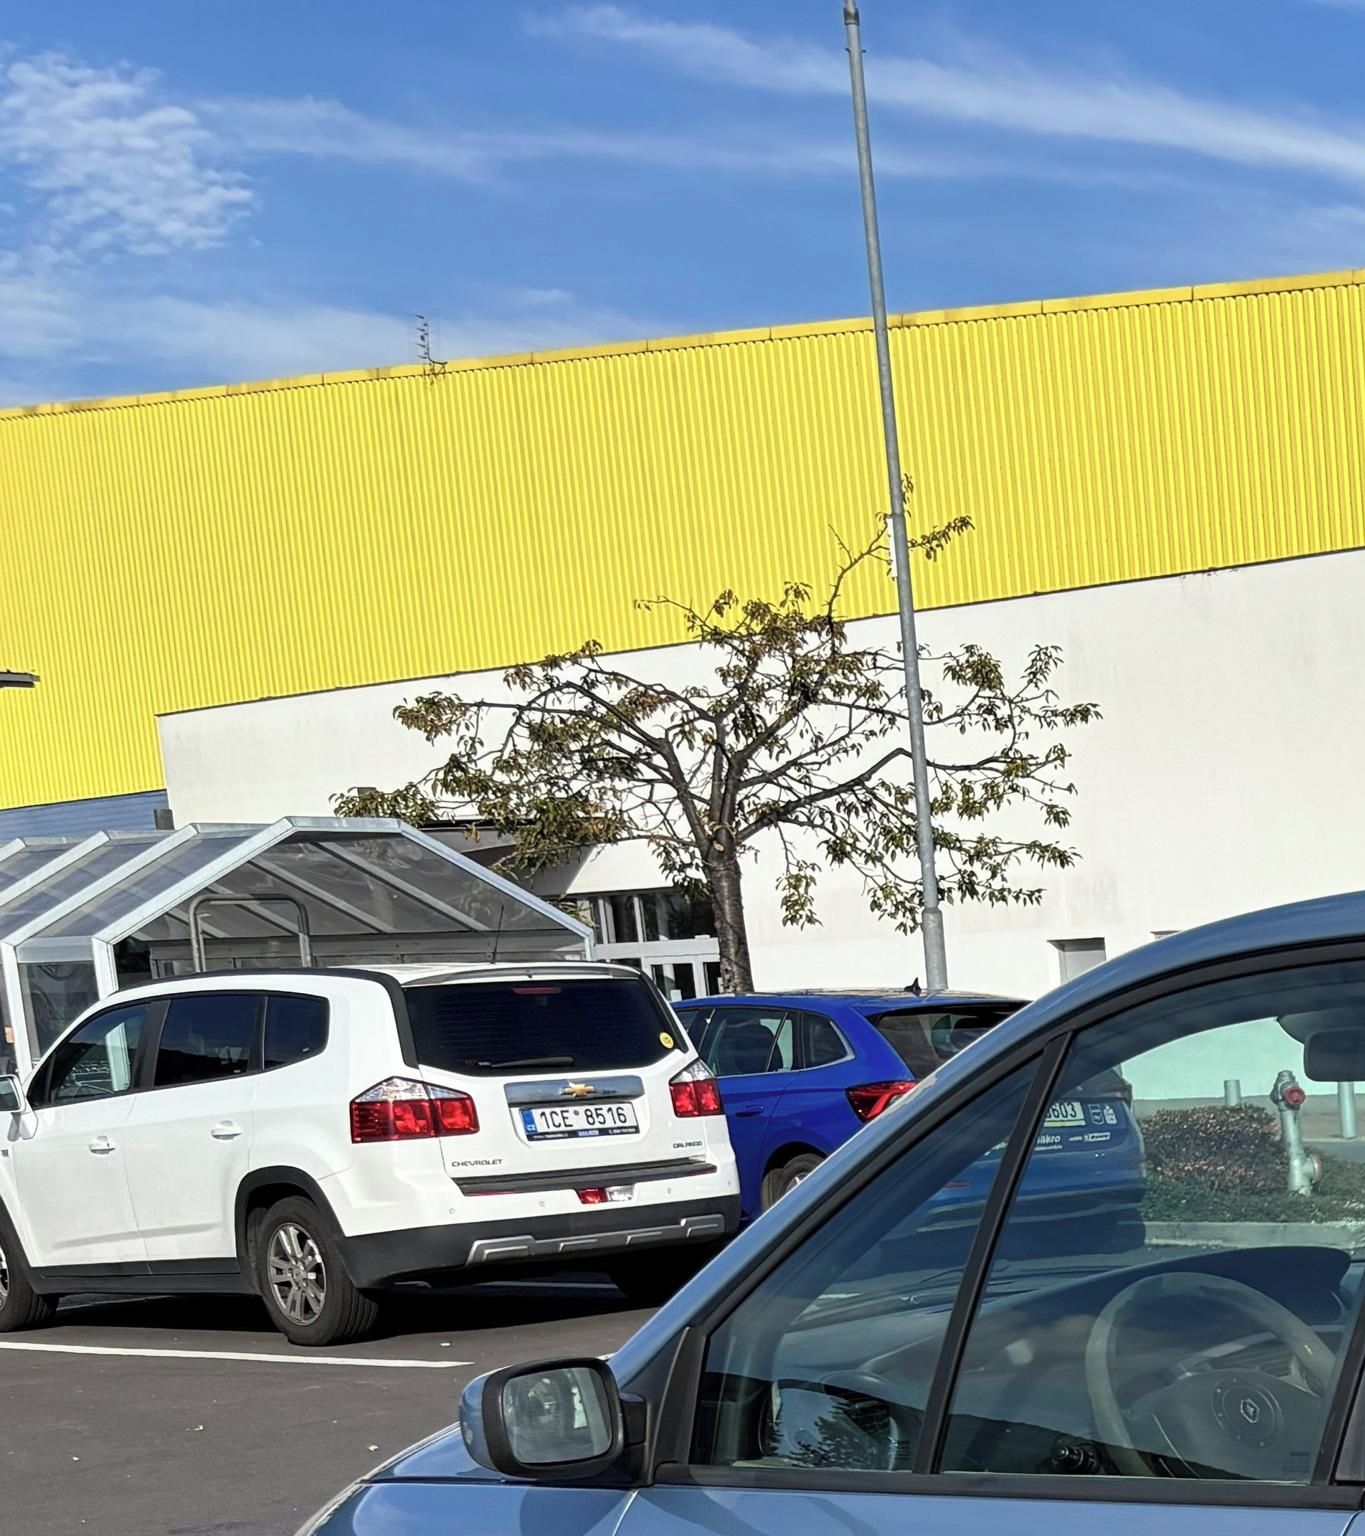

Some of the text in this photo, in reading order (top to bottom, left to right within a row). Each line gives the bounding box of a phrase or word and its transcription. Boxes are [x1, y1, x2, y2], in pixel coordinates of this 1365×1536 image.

[540, 1106, 628, 1129] 1CE 8516
[451, 1158, 504, 1168] CHEVROLET
